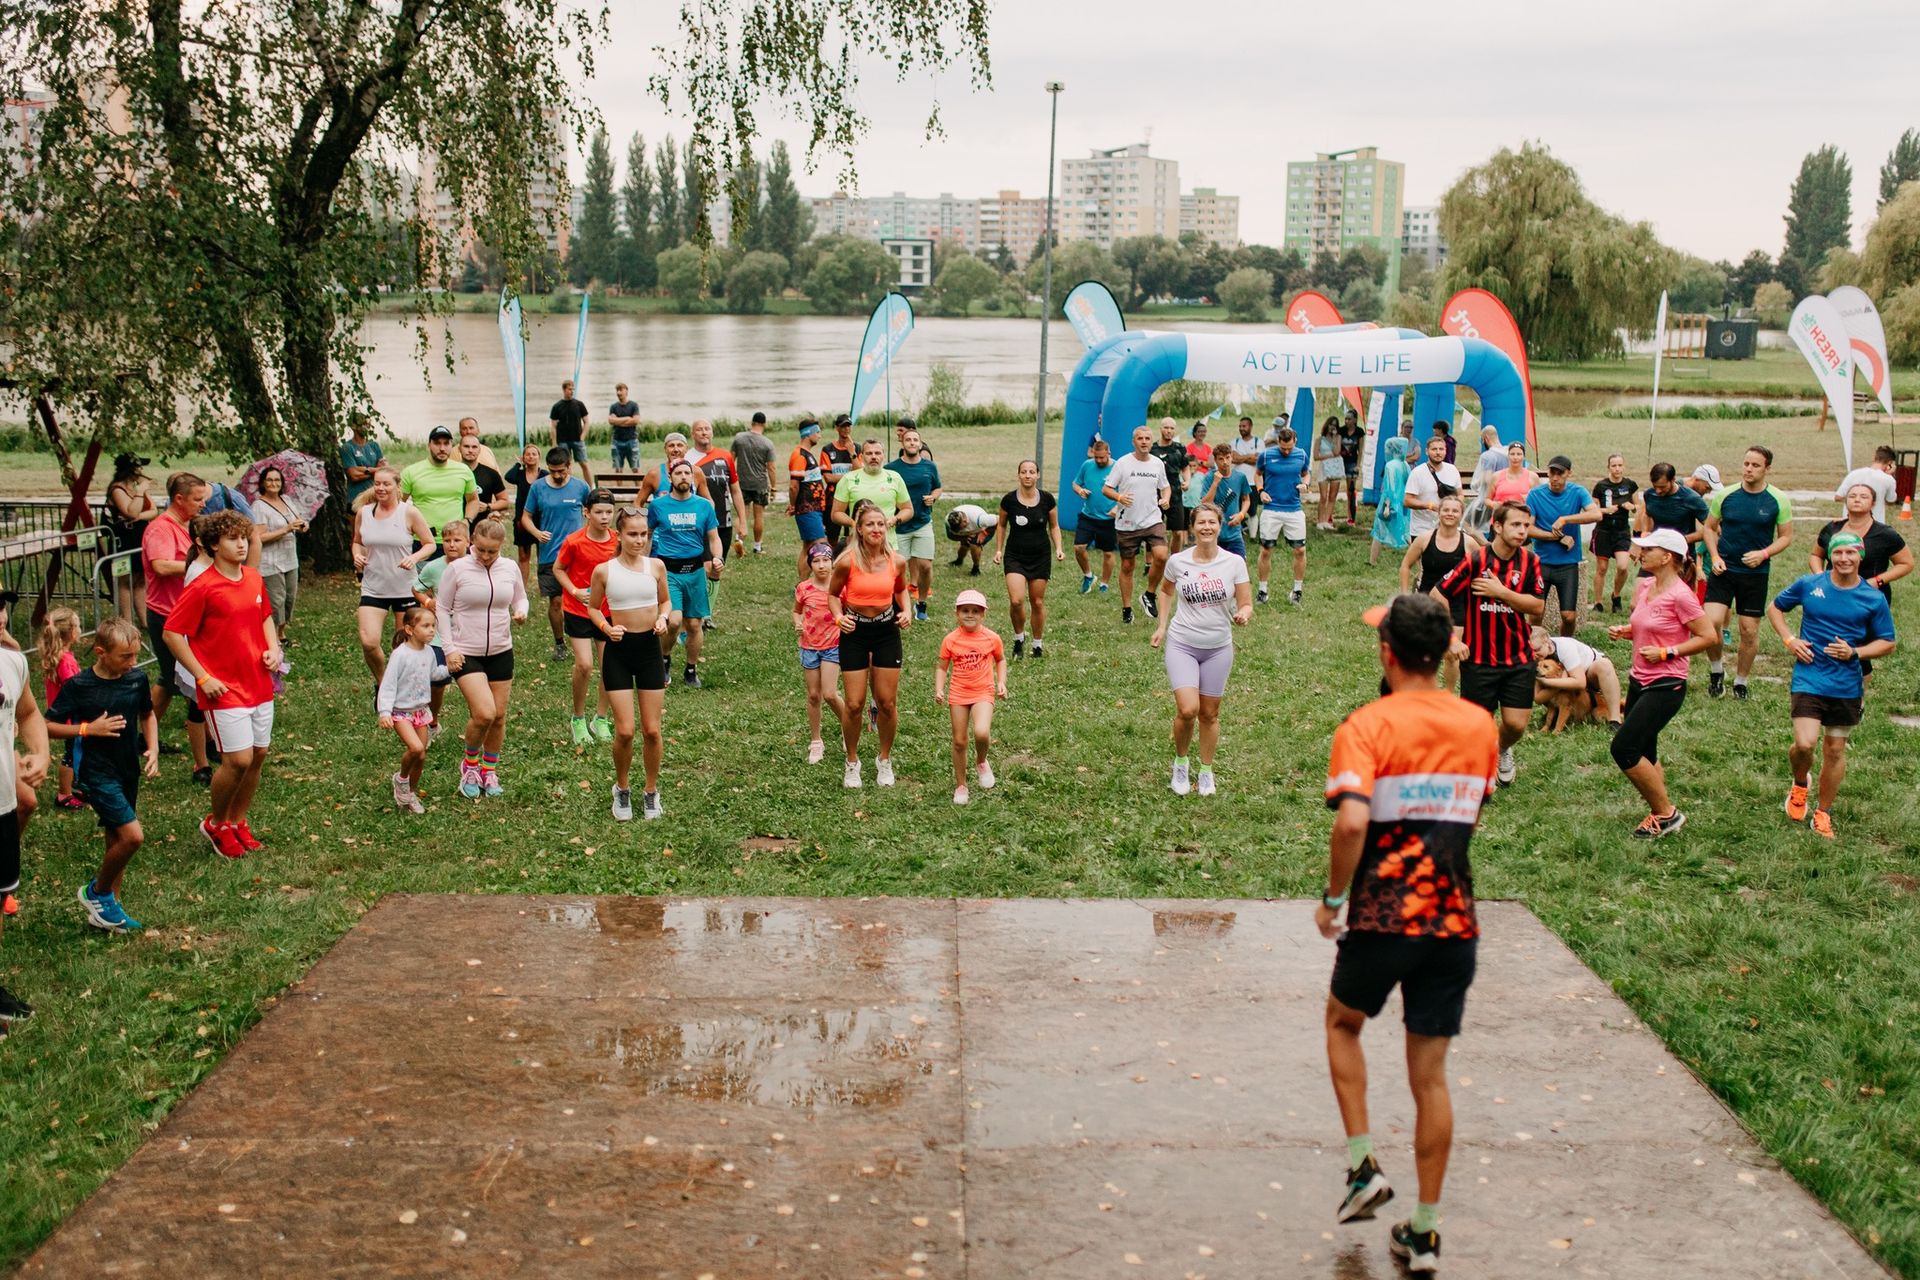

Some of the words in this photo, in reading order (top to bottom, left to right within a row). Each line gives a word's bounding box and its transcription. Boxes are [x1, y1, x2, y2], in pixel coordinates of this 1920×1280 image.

[1242, 350, 1342, 375] ACTIVE
[1360, 353, 1411, 374] LIFE
[1181, 583, 1200, 596] HALF
[1200, 578, 1224, 592] 2019
[1184, 588, 1227, 605] MARATHON
